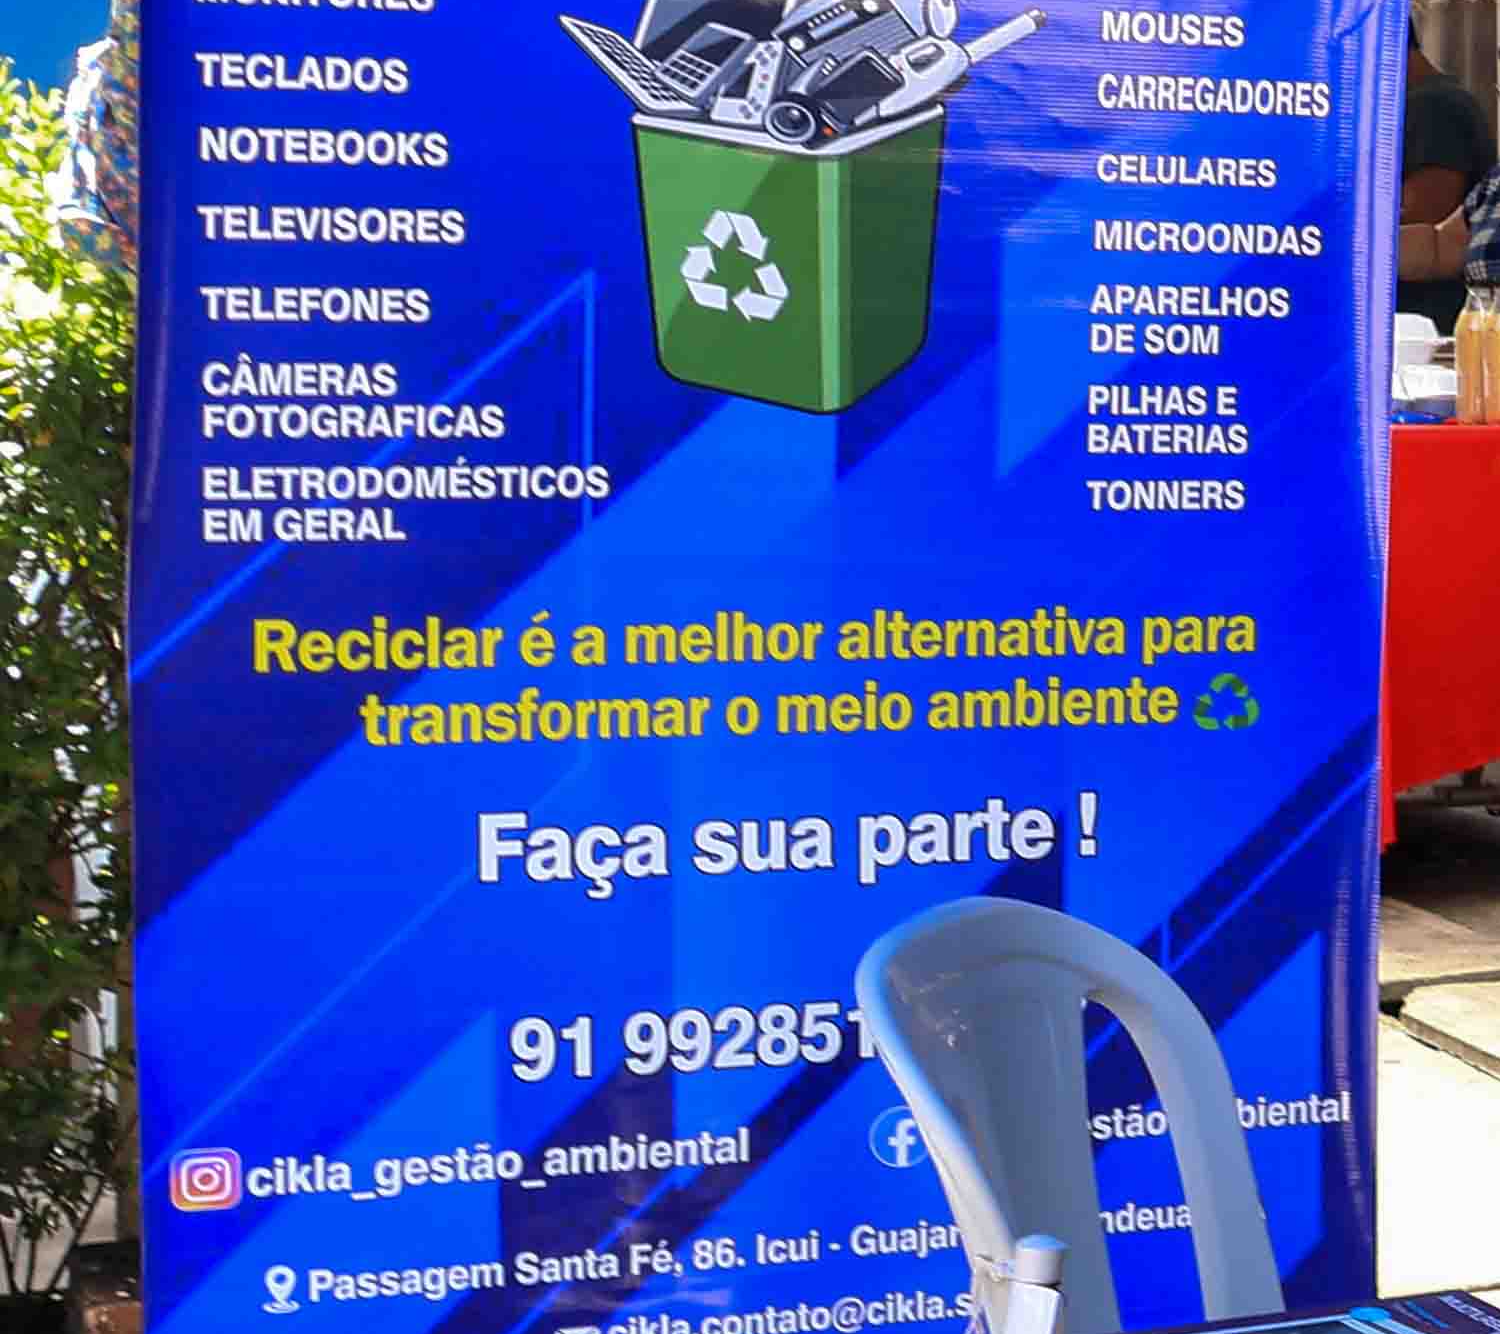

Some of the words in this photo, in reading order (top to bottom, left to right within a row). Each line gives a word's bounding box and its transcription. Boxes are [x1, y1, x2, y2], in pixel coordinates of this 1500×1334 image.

[1101, 10, 1245, 47] MOUSES
[197, 53, 409, 94] TECLADOS
[1098, 74, 1331, 118] CARREGADORES
[200, 127, 449, 167] NOTEBOOKS
[1097, 154, 1278, 188] CELULARES
[199, 205, 466, 245] TELEVISORES
[1093, 220, 1322, 257] MICROONDAS
[202, 287, 431, 323] TELEFONES
[1090, 284, 1290, 318] APARELHOS
[1090, 323, 1136, 354] DE
[1144, 323, 1220, 356] SOM
[202, 353, 398, 398] CÂMERAS
[1087, 385, 1208, 416] PILHAS
[1216, 387, 1237, 415] E
[203, 404, 506, 440] FOTOGRAFICAS
[1087, 422, 1250, 456] BATERIAS
[203, 456, 610, 501] ELETRODOMÉSTICOS
[1087, 480, 1246, 511] TONNERS
[203, 508, 264, 542] EM
[273, 507, 407, 542] GERAL
[252, 616, 502, 673] Reciclar
[519, 610, 555, 667] é
[571, 623, 606, 666] a
[625, 609, 822, 664] melhor
[838, 605, 1126, 661] alternativa
[1142, 613, 1257, 665] para
[359, 687, 711, 746] transformar
[726, 695, 761, 736] o
[777, 679, 913, 734] meio
[926, 676, 1179, 730] ambiente
[477, 811, 669, 899] Faça
[692, 815, 834, 874] sua
[858, 798, 1056, 885] parte
[1078, 792, 1098, 856] !
[509, 1015, 593, 1082] 91
[246, 1126, 751, 1202] cikla_gestão_ambiental
[309, 1259, 504, 1303] Passagem
[513, 1248, 620, 1286] Santa
[629, 1239, 683, 1279] Fé,
[693, 1237, 746, 1270] 86.
